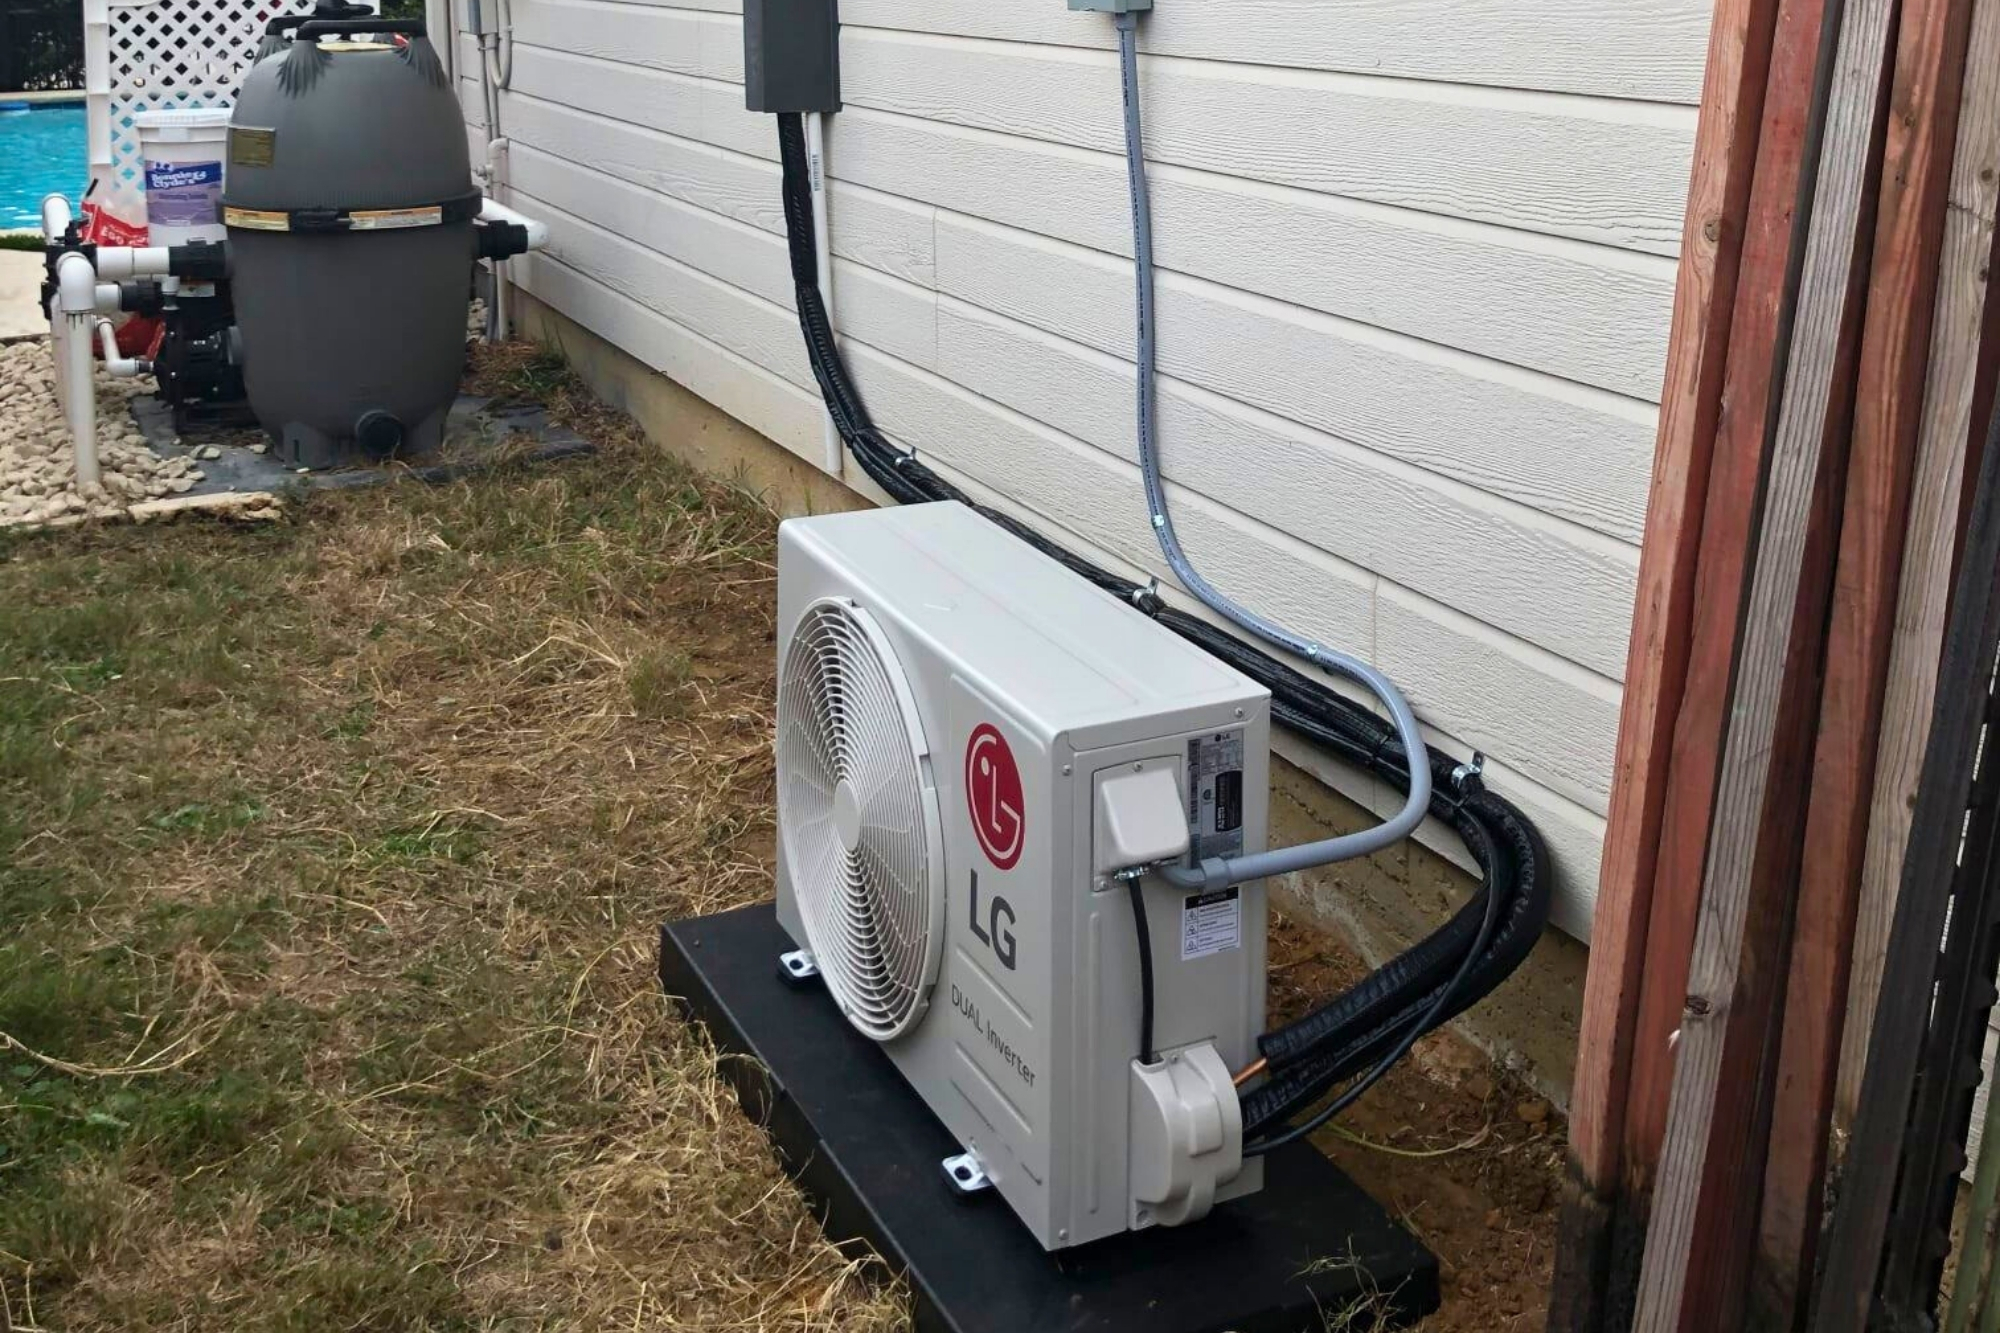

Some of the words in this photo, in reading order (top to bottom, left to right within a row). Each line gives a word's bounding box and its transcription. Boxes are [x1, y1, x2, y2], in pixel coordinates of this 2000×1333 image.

[970, 868, 1017, 971] LG
[951, 983, 983, 1033] DUAL
[986, 1020, 1035, 1088] Inverter
